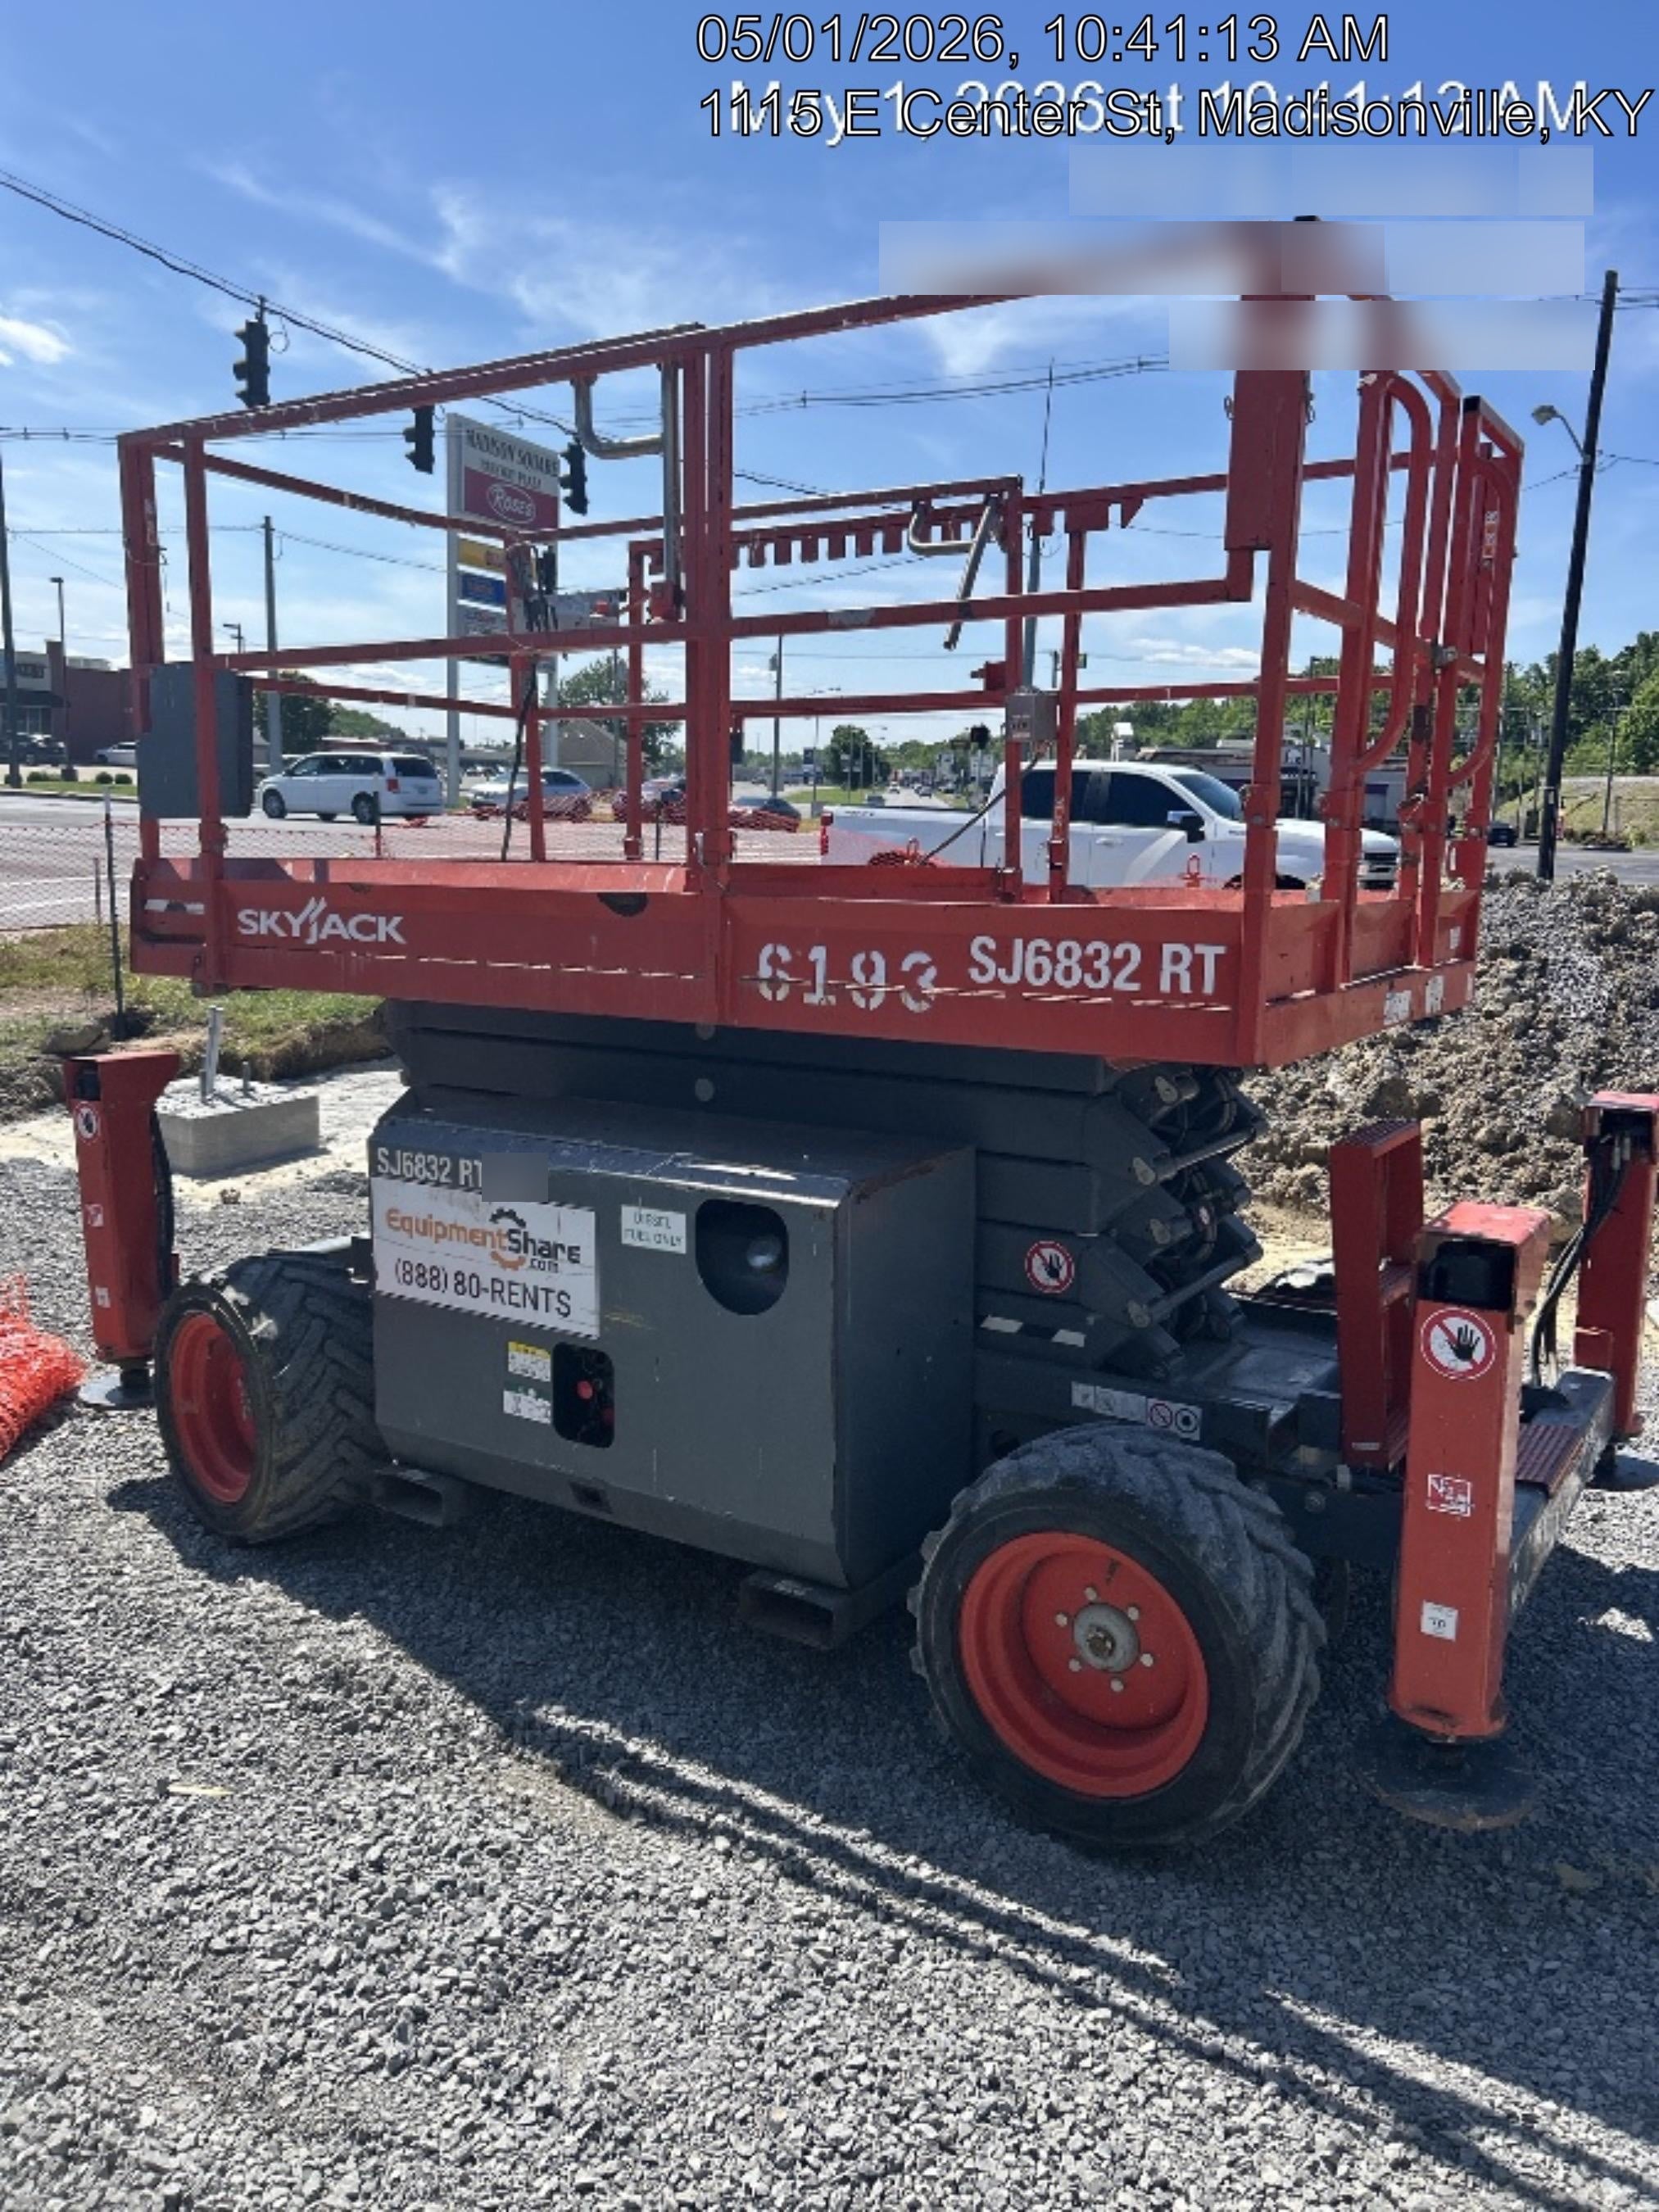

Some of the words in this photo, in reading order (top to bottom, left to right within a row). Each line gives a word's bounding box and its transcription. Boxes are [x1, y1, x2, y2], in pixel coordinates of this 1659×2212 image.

[237, 896, 407, 945] SKYJACK
[757, 943, 937, 1013] 6193
[968, 935, 1142, 992] SJ6832
[1159, 943, 1226, 995] RT
[377, 1147, 452, 1184] SJ6832
[459, 1158, 482, 1188] RT
[395, 1258, 448, 1294] (888)
[453, 1271, 572, 1318] 80-RENTS
